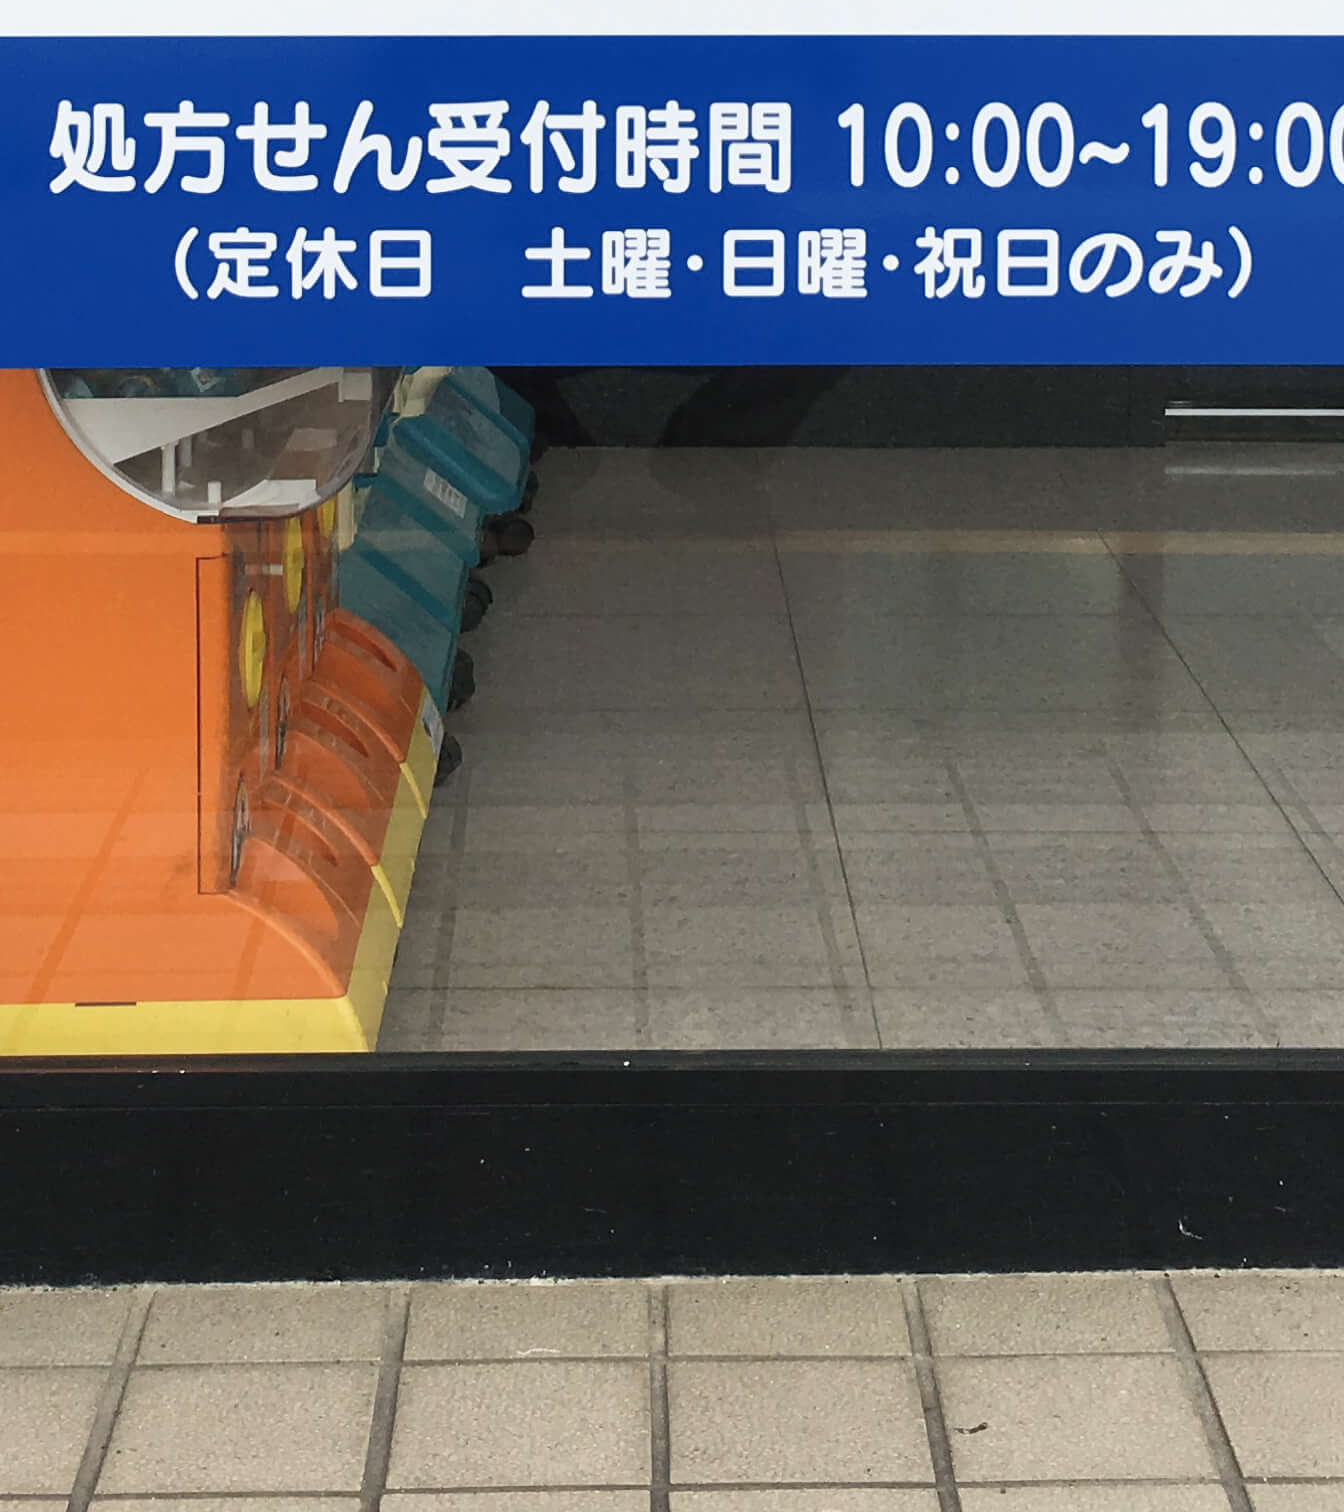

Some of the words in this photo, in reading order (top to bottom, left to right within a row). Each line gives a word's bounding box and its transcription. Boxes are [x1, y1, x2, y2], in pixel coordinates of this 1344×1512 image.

[49, 100, 792, 194] 処方せん受付時間
